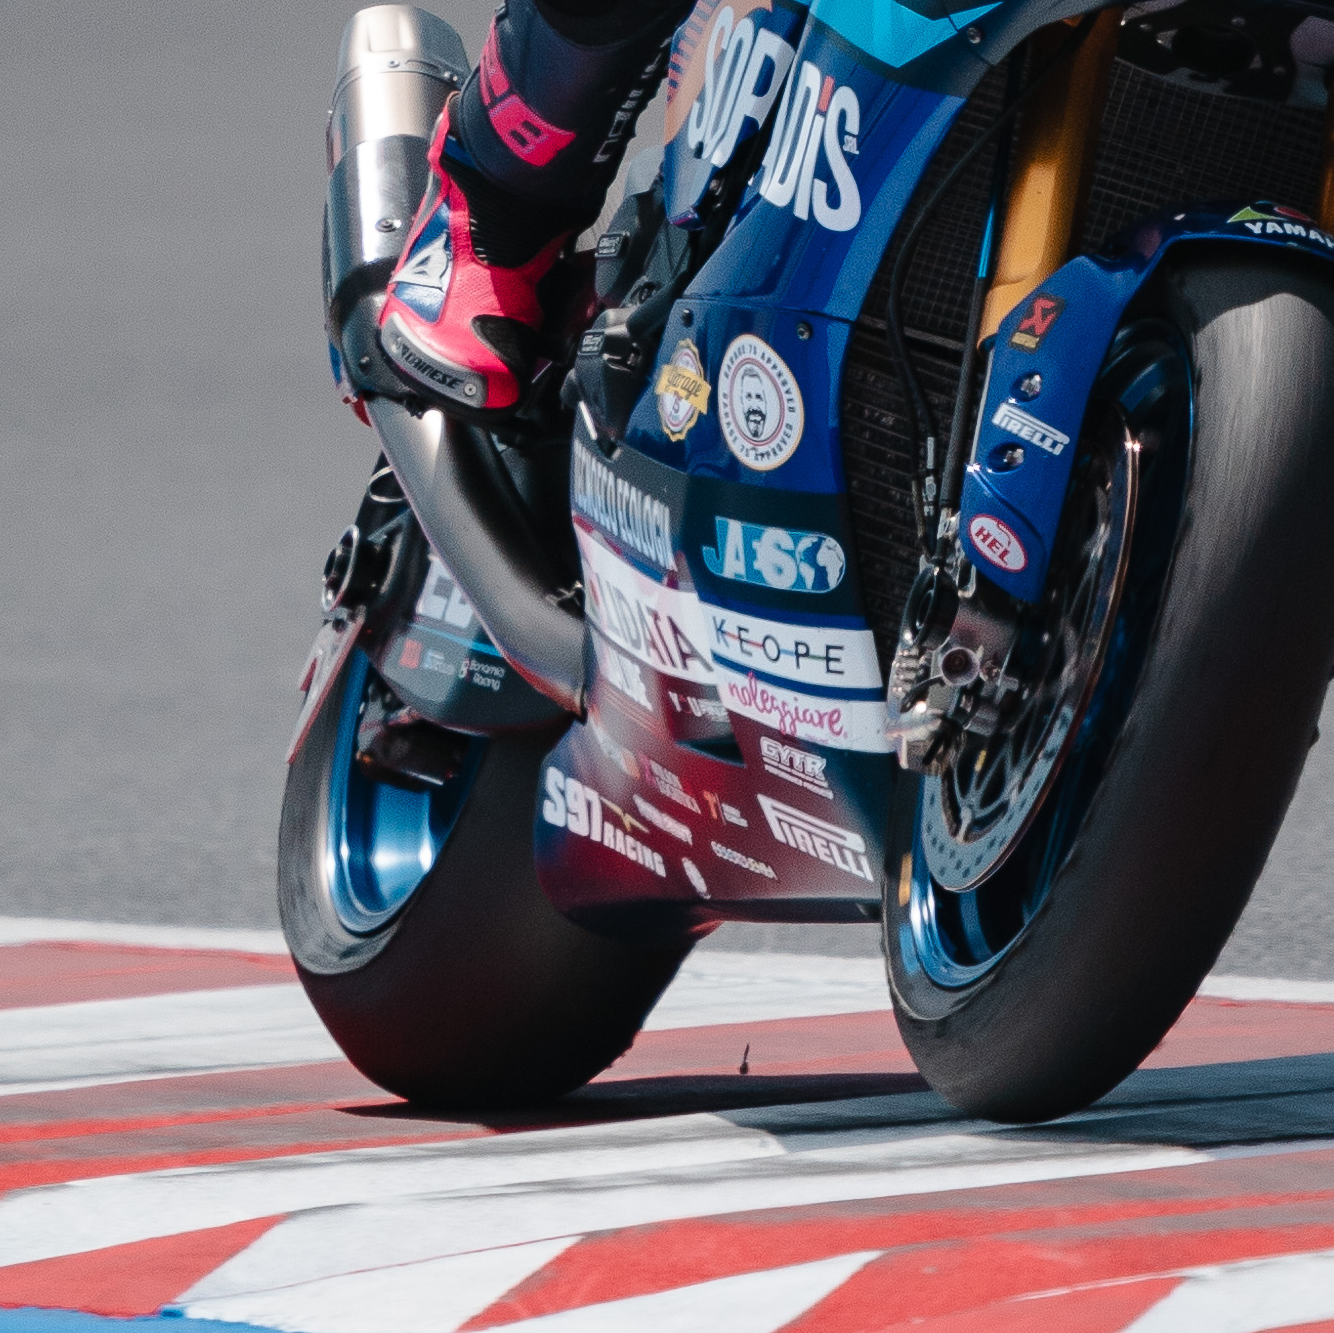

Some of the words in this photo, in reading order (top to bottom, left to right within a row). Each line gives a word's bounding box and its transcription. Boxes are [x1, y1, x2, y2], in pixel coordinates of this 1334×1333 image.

[991, 401, 1070, 456] PIRELLI
[974, 525, 1011, 566] HEL
[713, 615, 845, 676] KEOPE
[760, 735, 827, 782] GYTR
[542, 766, 604, 843] S97
[603, 820, 667, 878] RACING
[756, 793, 874, 883] PIRELLI
